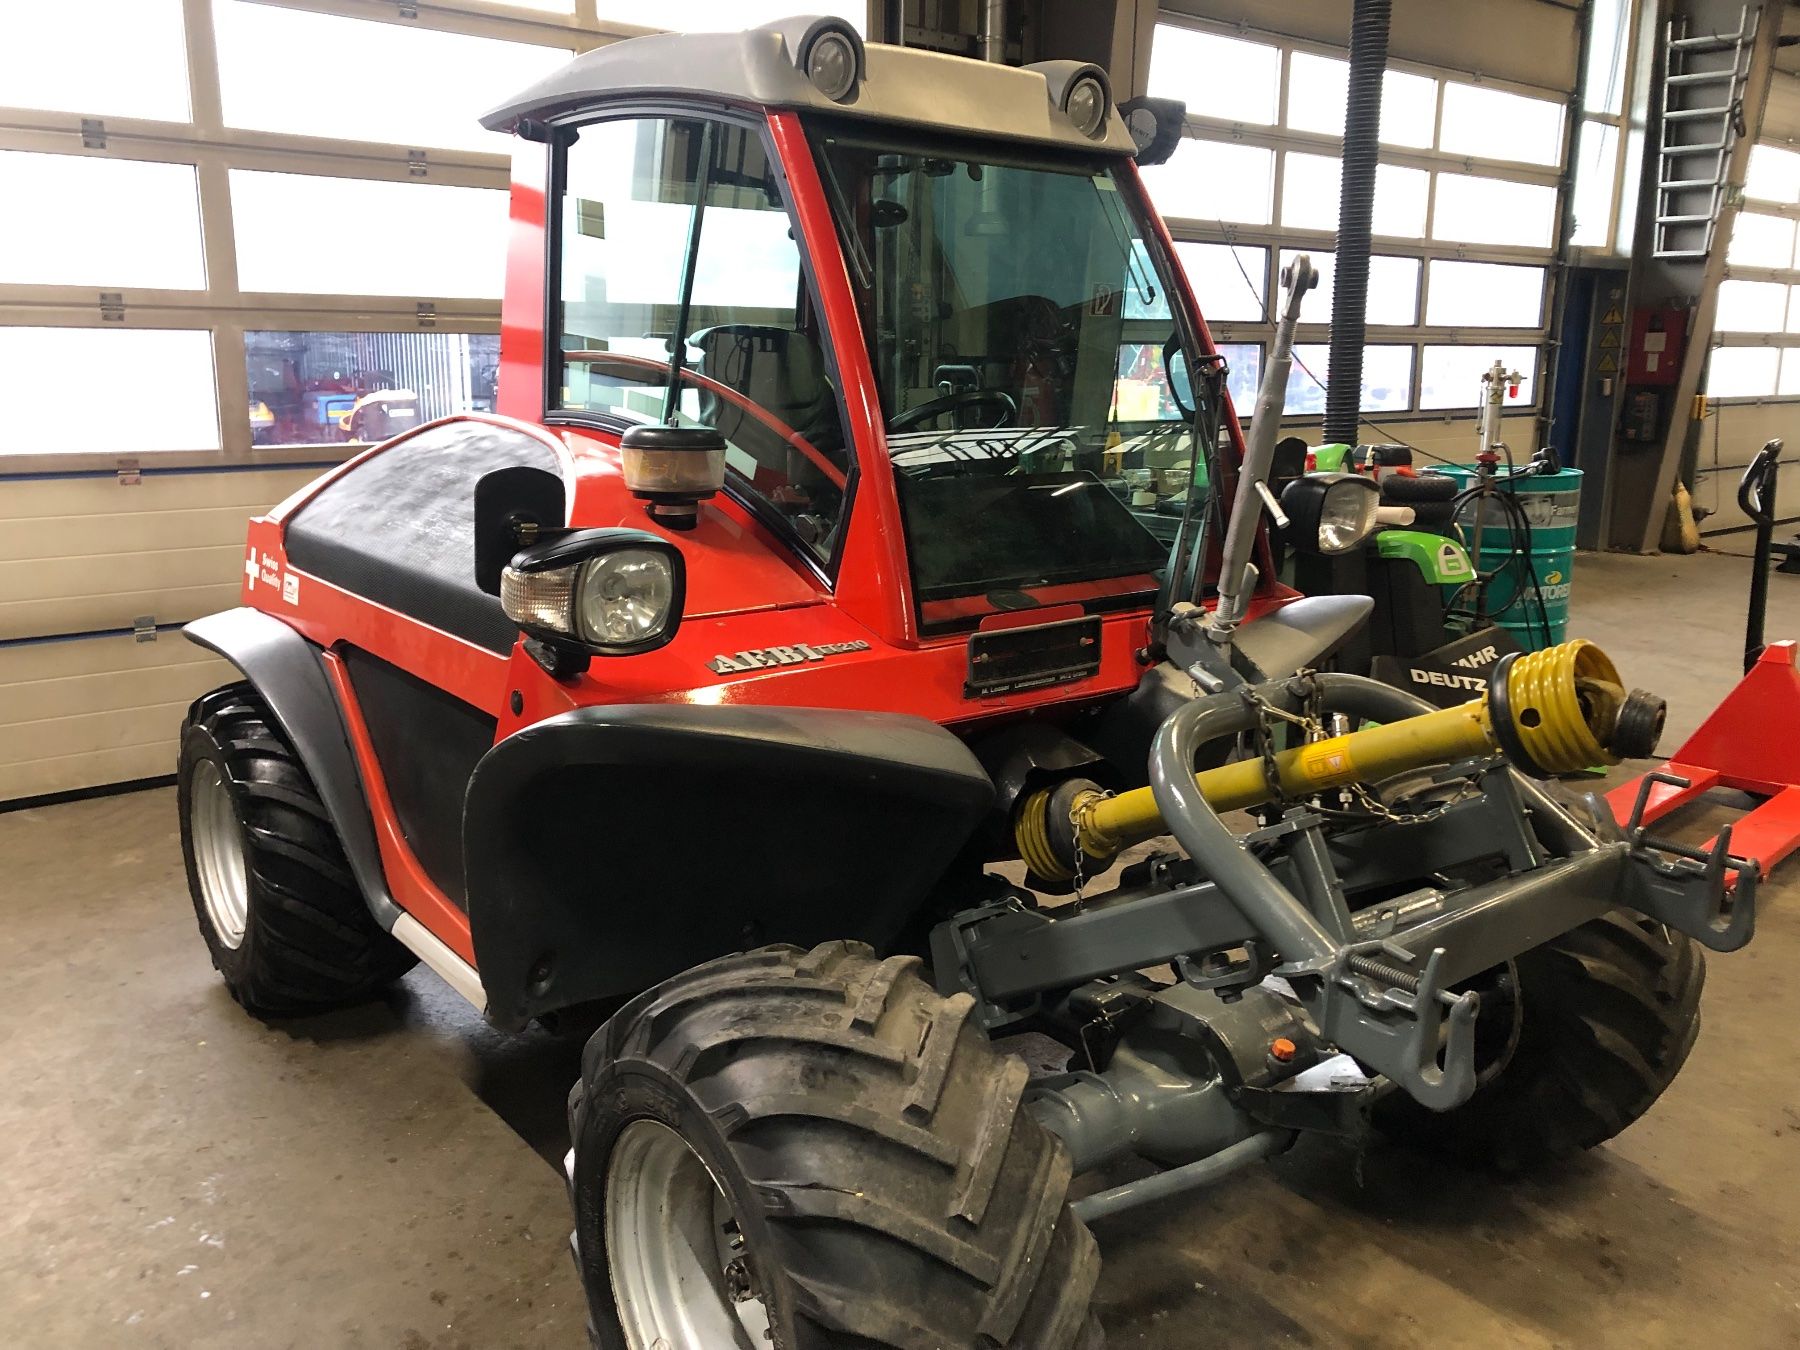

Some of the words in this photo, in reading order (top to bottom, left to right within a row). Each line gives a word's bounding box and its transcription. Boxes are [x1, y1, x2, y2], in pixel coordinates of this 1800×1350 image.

[262, 552, 279, 571] Swiss
[261, 568, 281, 591] Quality
[1523, 583, 1571, 600] MTORE
[707, 643, 824, 674] AEBI
[1410, 668, 1489, 692] DEUTZ
